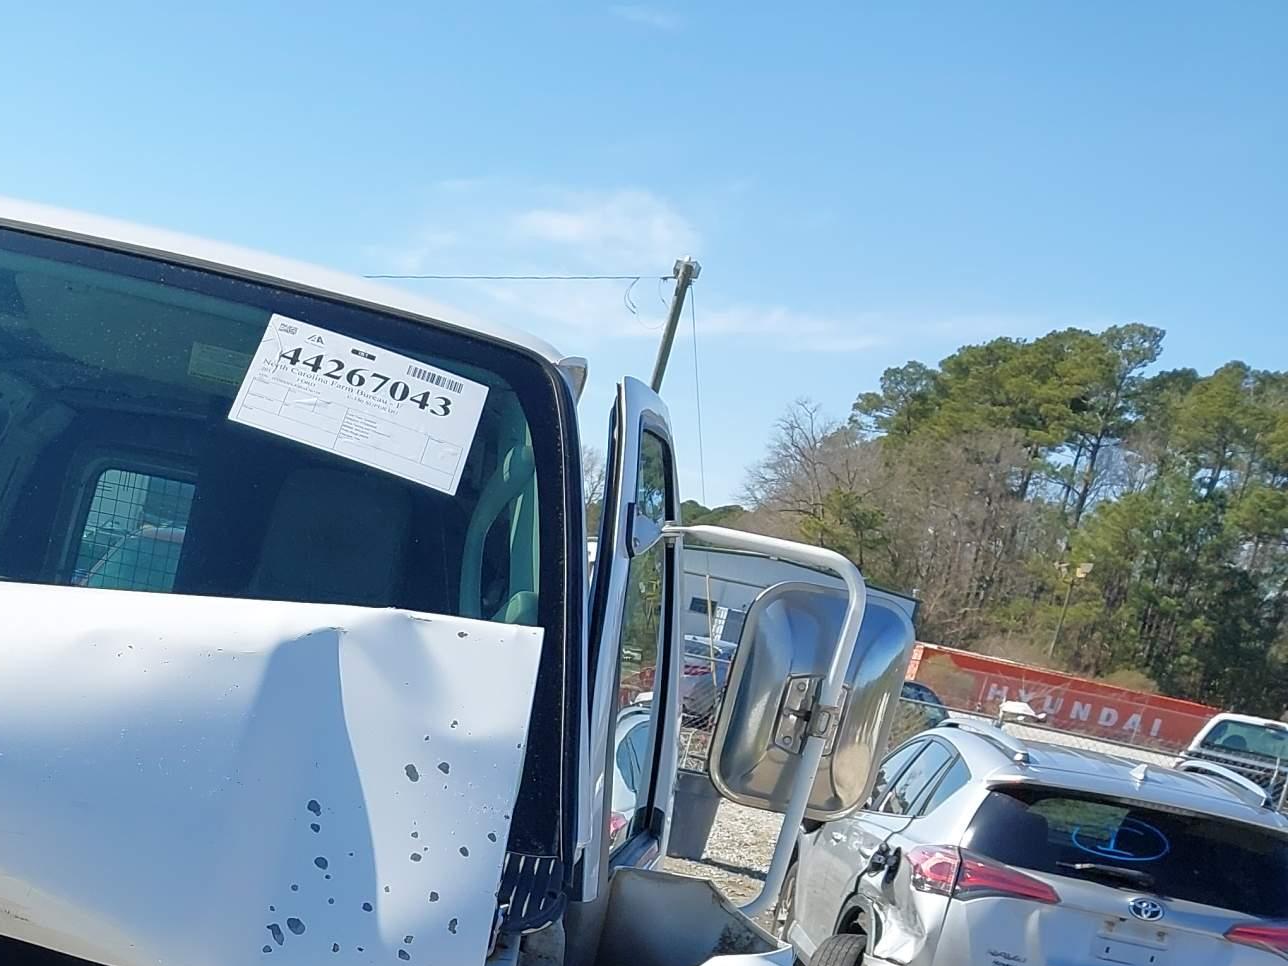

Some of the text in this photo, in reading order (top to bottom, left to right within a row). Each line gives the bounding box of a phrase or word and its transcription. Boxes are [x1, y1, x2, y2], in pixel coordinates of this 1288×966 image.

[279, 347, 452, 417] 44267043
[290, 366, 329, 384] Carolina
[330, 378, 355, 392] Farm
[356, 388, 389, 404] Bureau
[986, 683, 1162, 737] HYUNDAI
